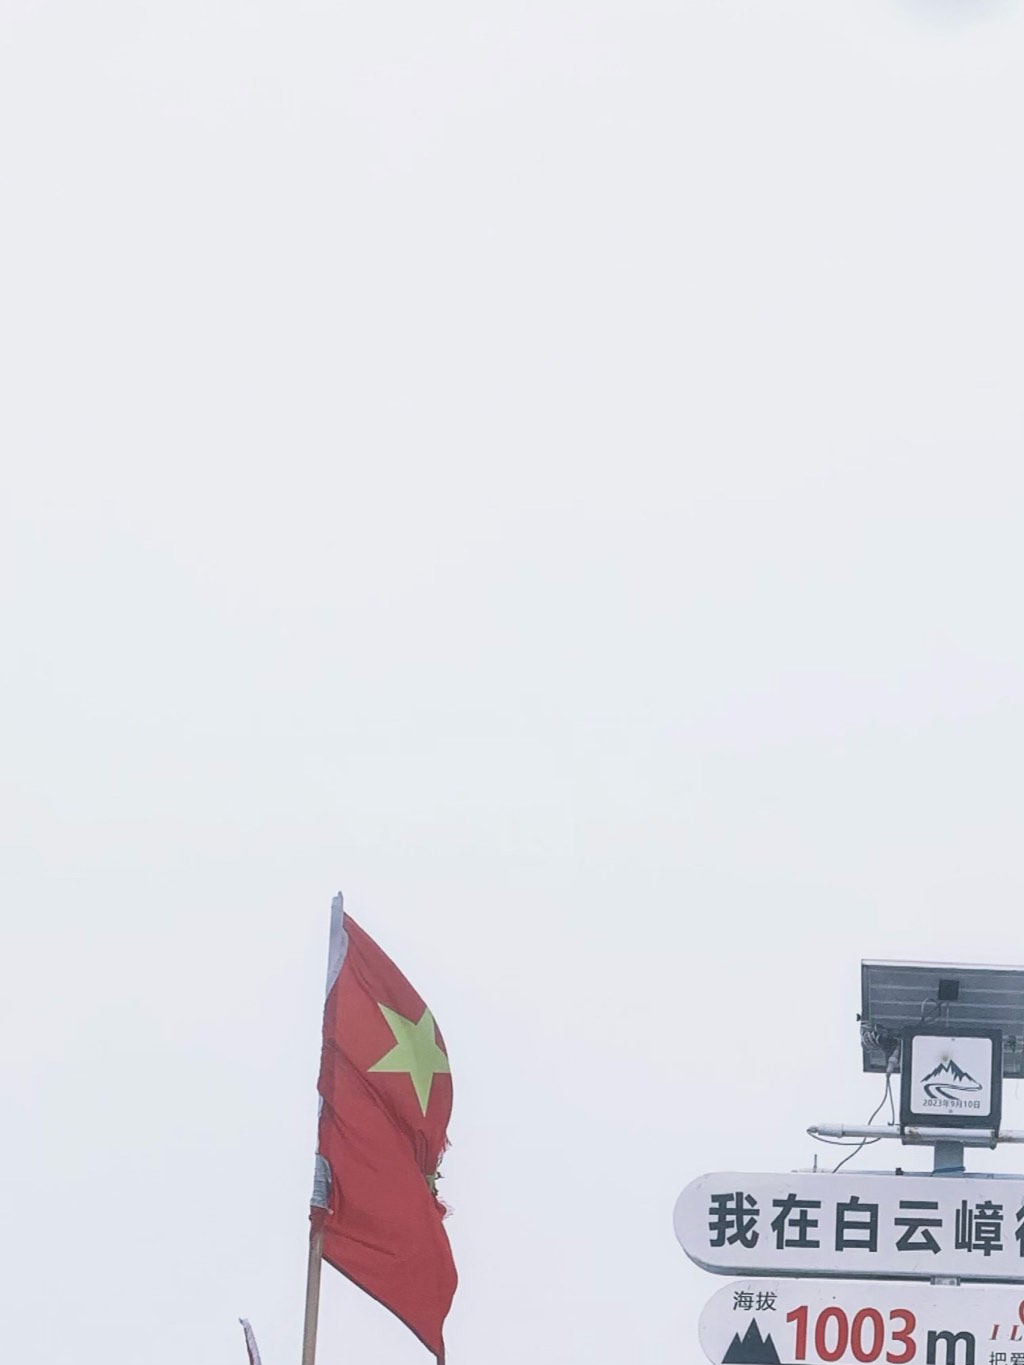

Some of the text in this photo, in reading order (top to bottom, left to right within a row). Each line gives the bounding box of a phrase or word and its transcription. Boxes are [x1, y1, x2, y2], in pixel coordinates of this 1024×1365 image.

[922, 1099, 981, 1109] 2023年9月10日
[733, 1291, 777, 1311] 海拔
